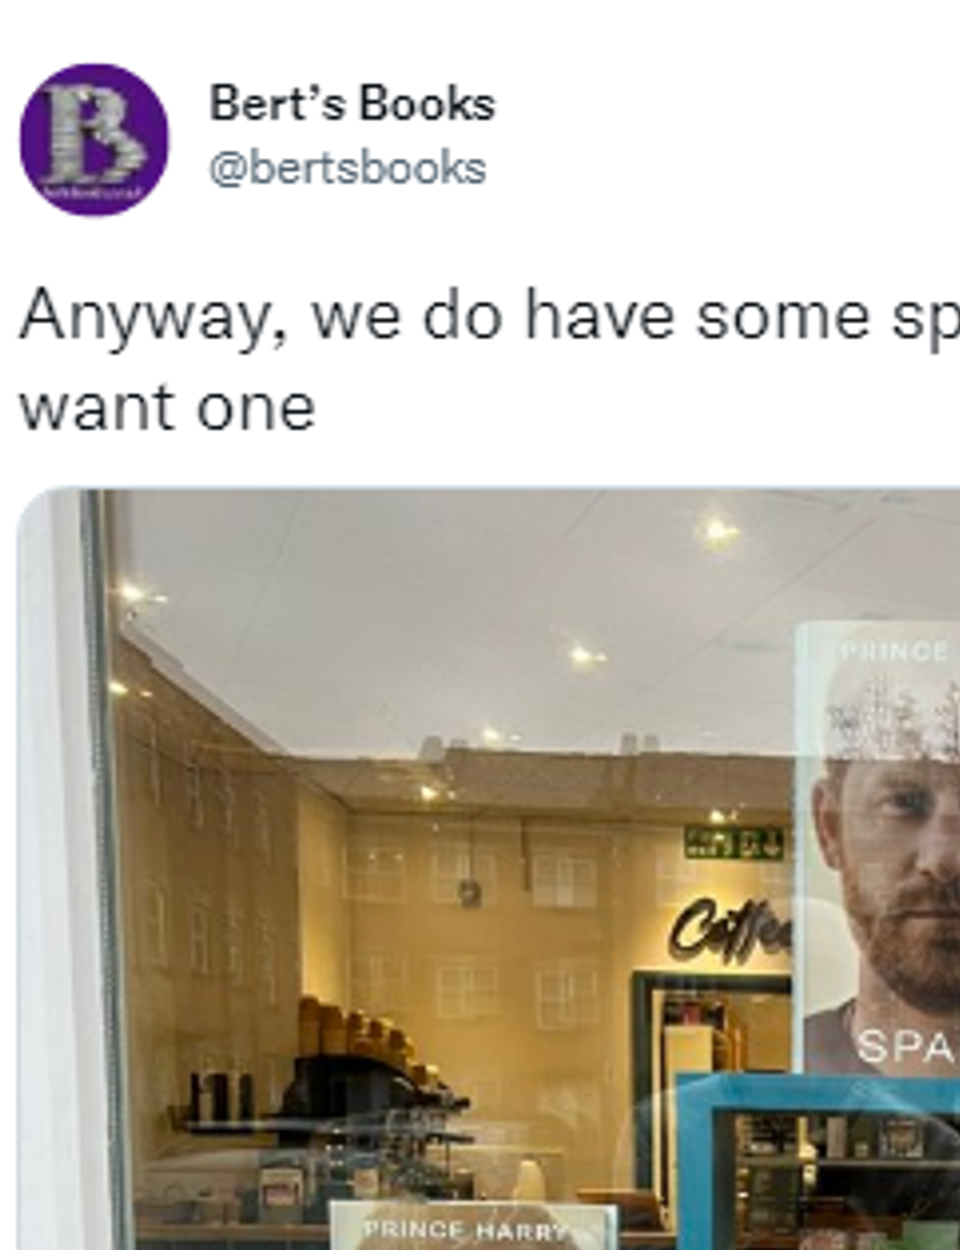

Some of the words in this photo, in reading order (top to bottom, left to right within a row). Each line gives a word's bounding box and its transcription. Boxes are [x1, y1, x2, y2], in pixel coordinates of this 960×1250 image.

[841, 640, 949, 662] PRINCE
[364, 1220, 463, 1238] PRINCE
[476, 1223, 570, 1242] HARRY
